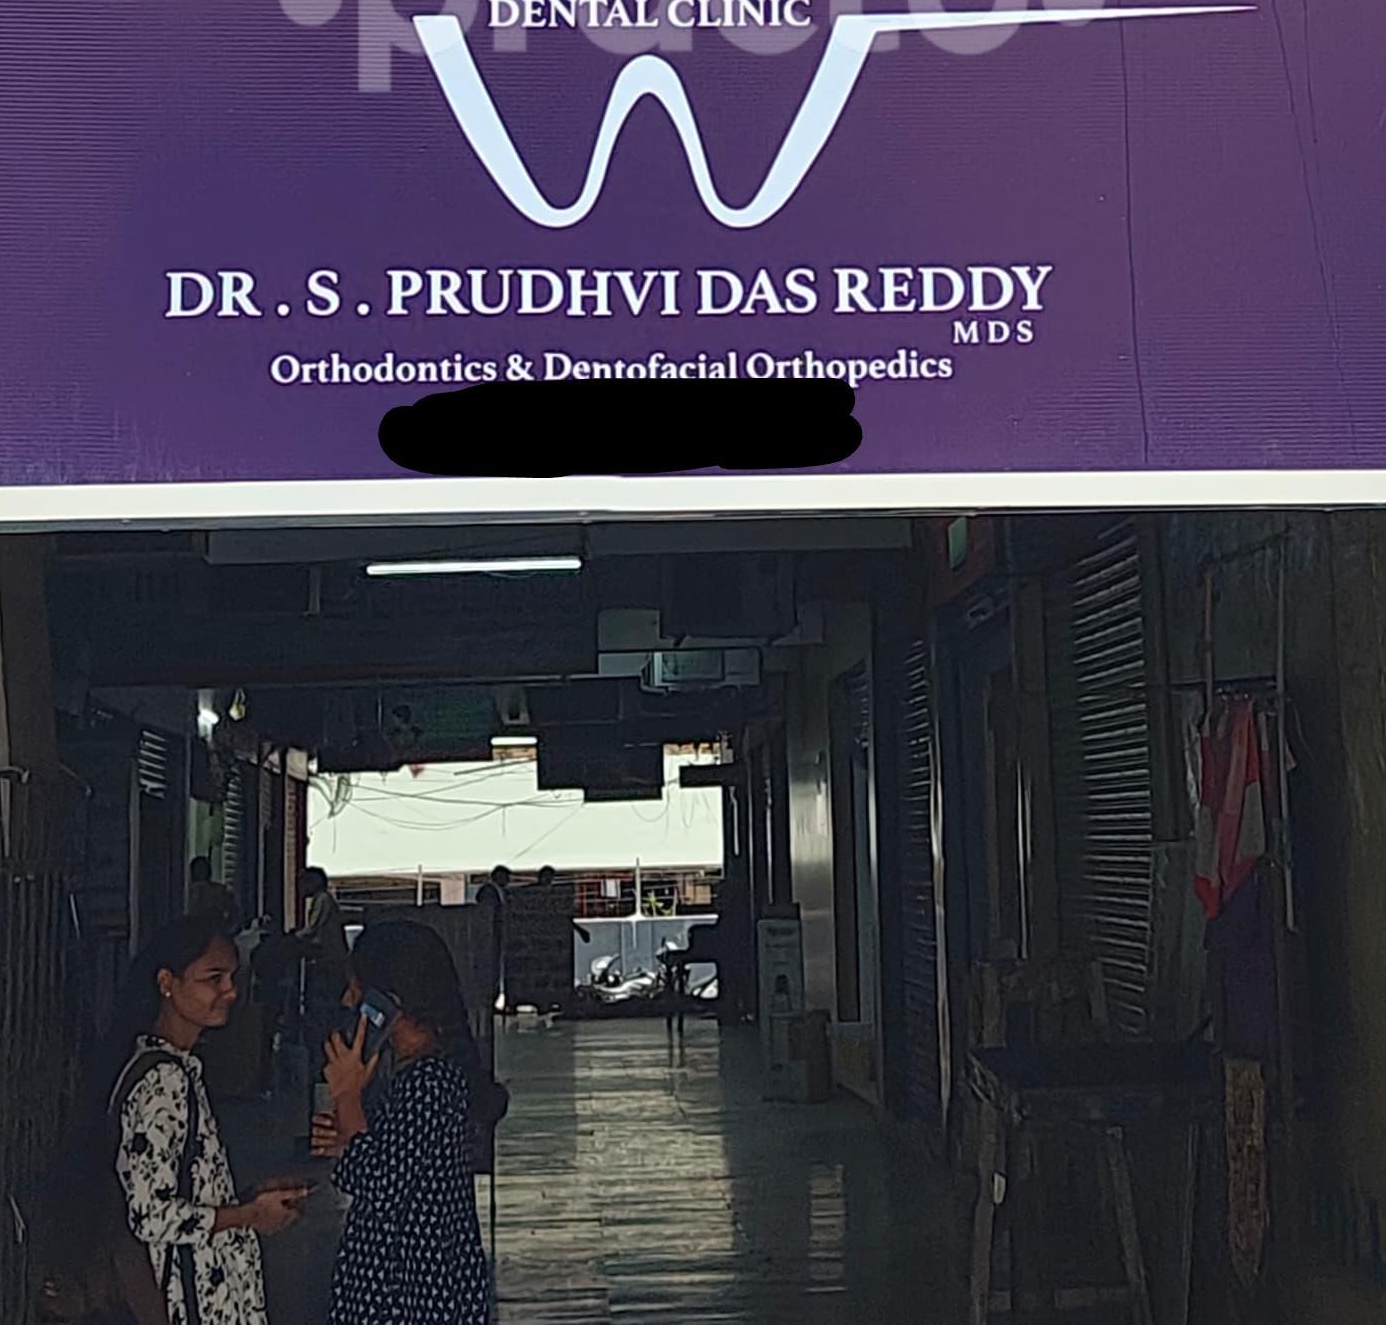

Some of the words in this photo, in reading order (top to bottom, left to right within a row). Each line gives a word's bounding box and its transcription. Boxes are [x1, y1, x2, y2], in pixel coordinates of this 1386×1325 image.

[386, 267, 680, 317] PRUDHVI
[696, 267, 818, 315] DAS
[833, 265, 1053, 313] REDDY
[270, 351, 498, 384] Orthodontics
[505, 353, 535, 381] &
[542, 351, 738, 380] Dentofacial
[745, 349, 954, 387] Orthopedics
